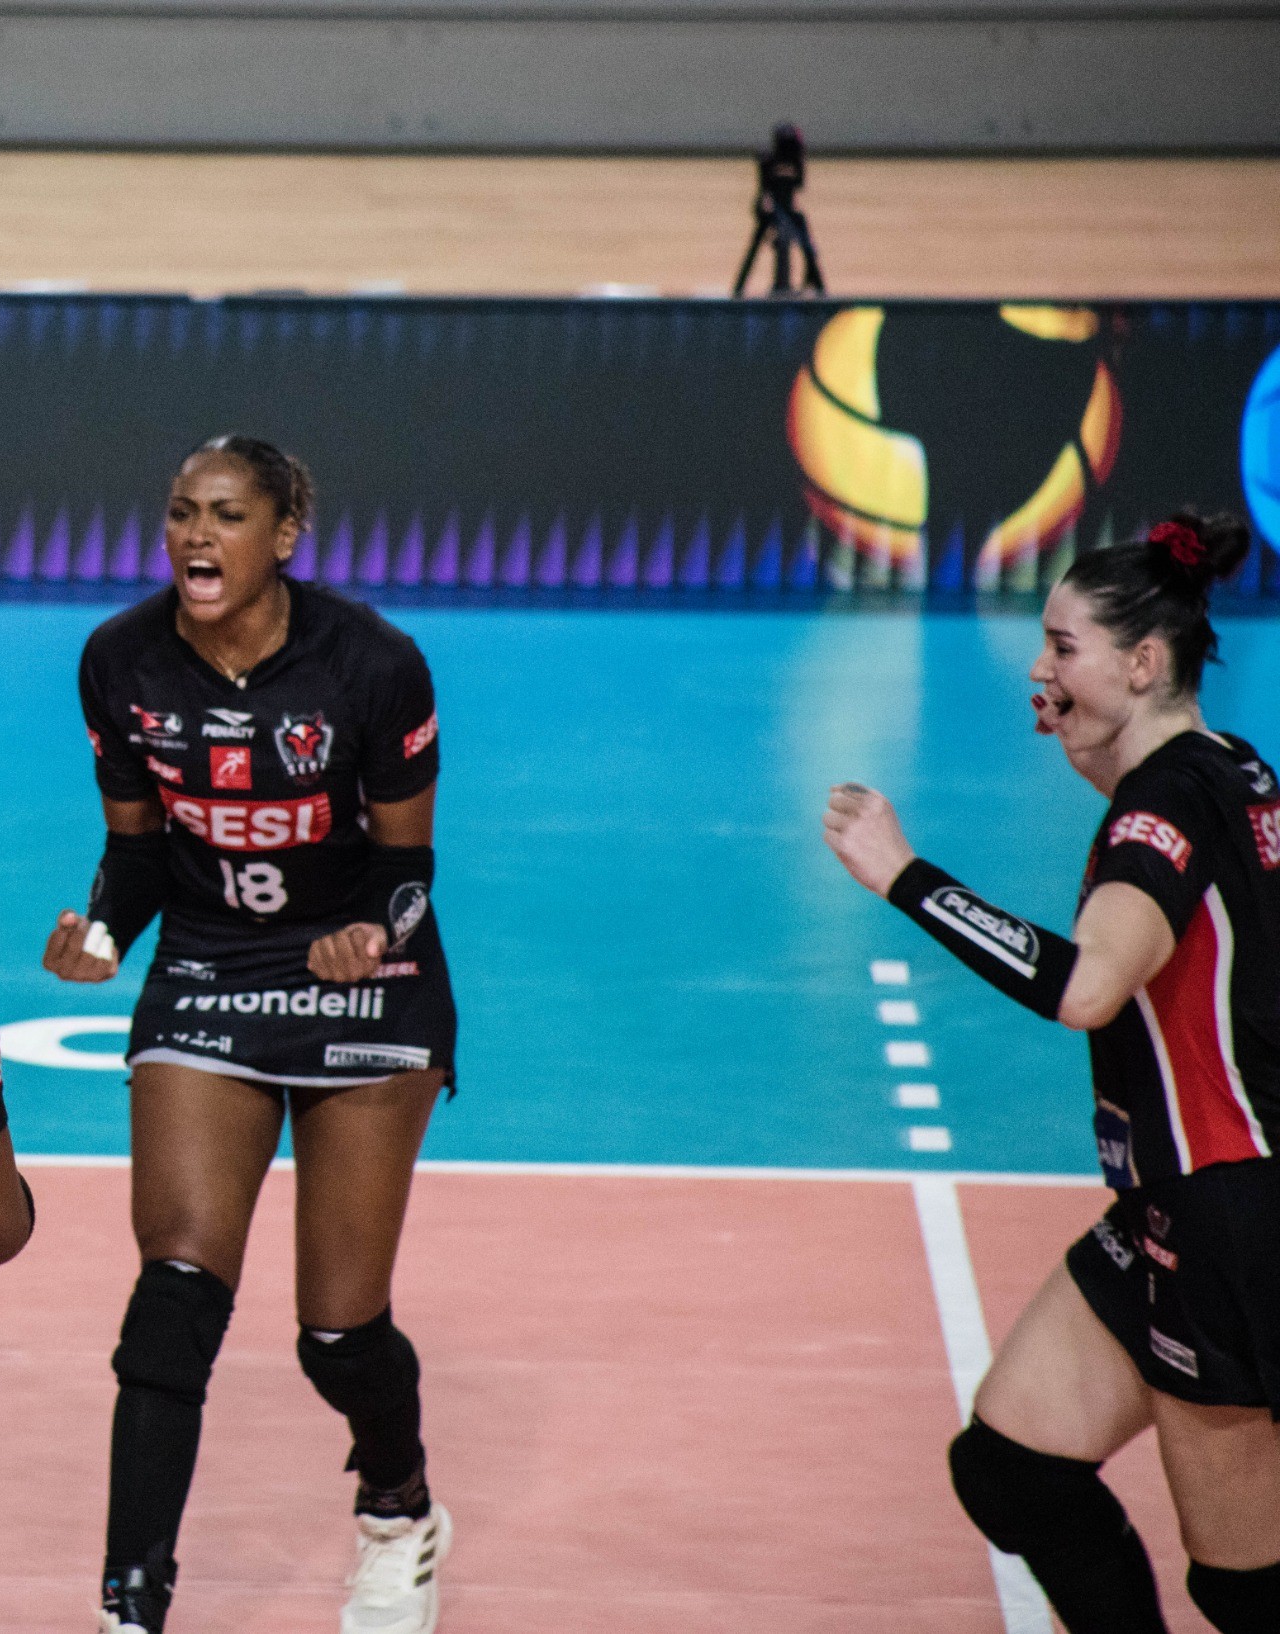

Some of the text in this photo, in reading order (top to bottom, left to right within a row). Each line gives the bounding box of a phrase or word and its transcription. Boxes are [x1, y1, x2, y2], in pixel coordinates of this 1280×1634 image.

[201, 723, 256, 739] PENALTY
[172, 800, 314, 848] SESI
[1108, 813, 1187, 860] SESI
[218, 858, 288, 914] 18
